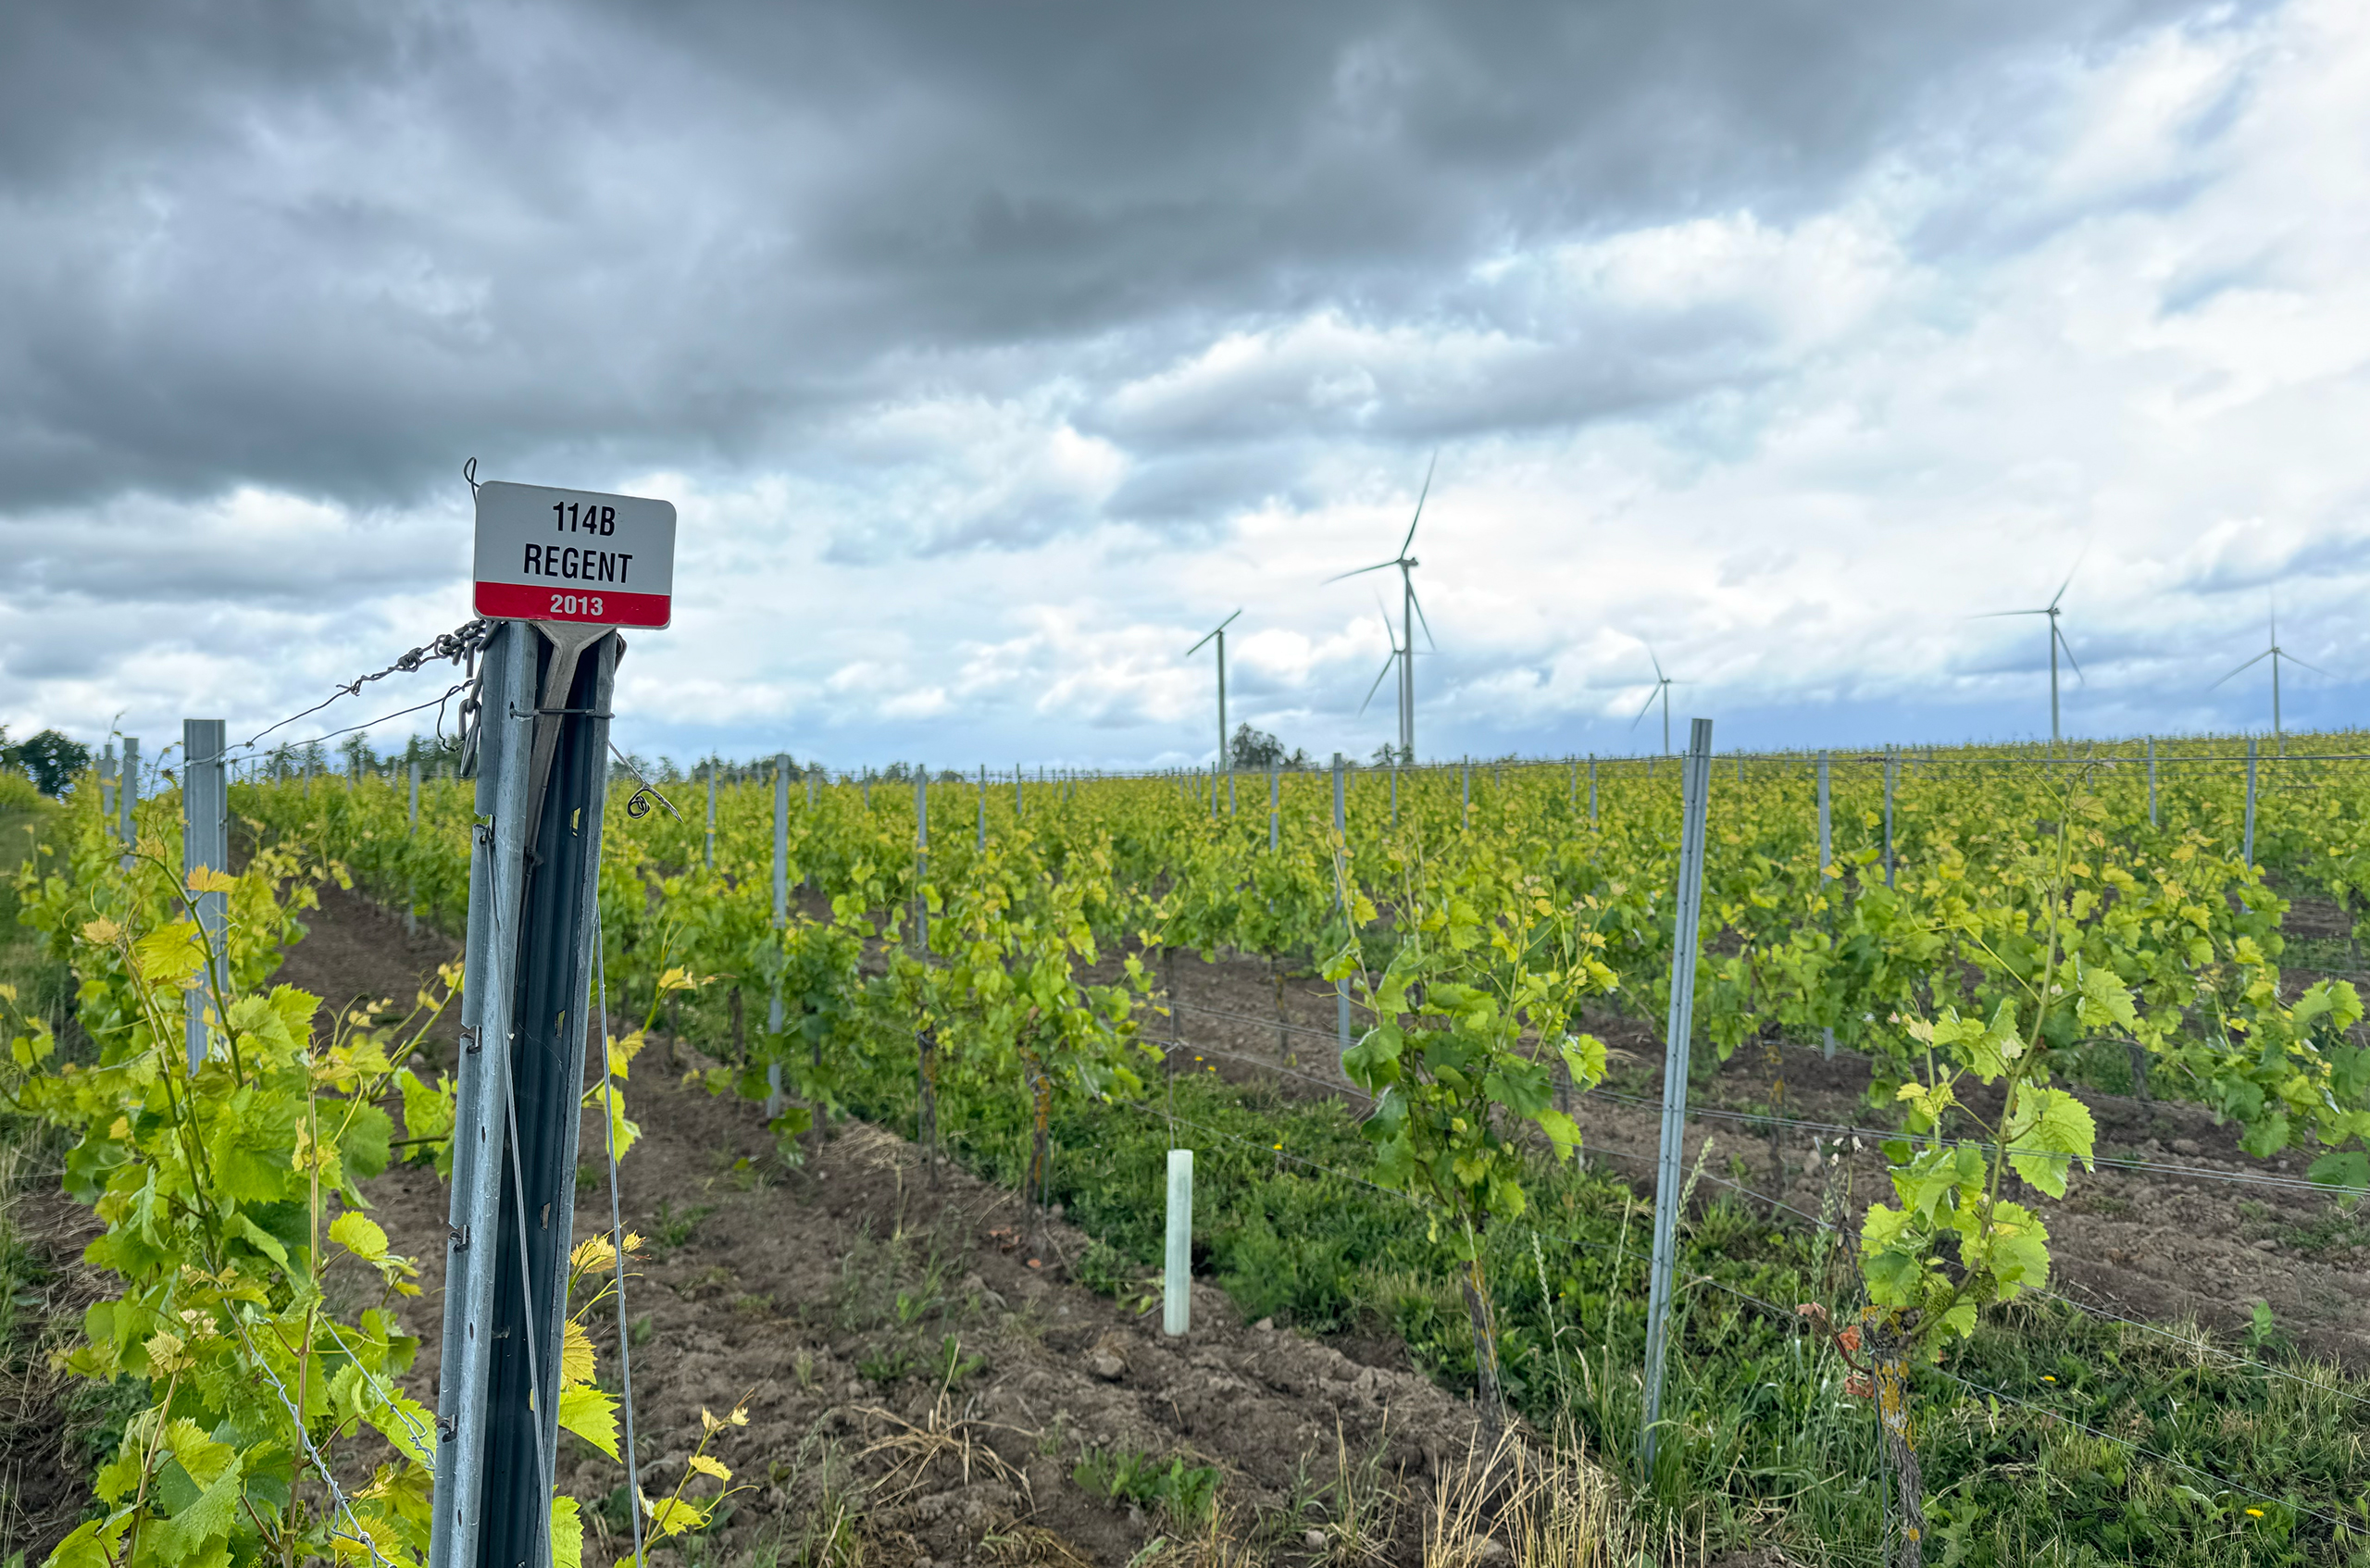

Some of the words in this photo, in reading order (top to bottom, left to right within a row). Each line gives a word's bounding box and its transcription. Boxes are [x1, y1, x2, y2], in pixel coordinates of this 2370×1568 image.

[552, 501, 616, 537] 114B
[523, 542, 633, 584] REGENT
[550, 594, 604, 616] 2013
